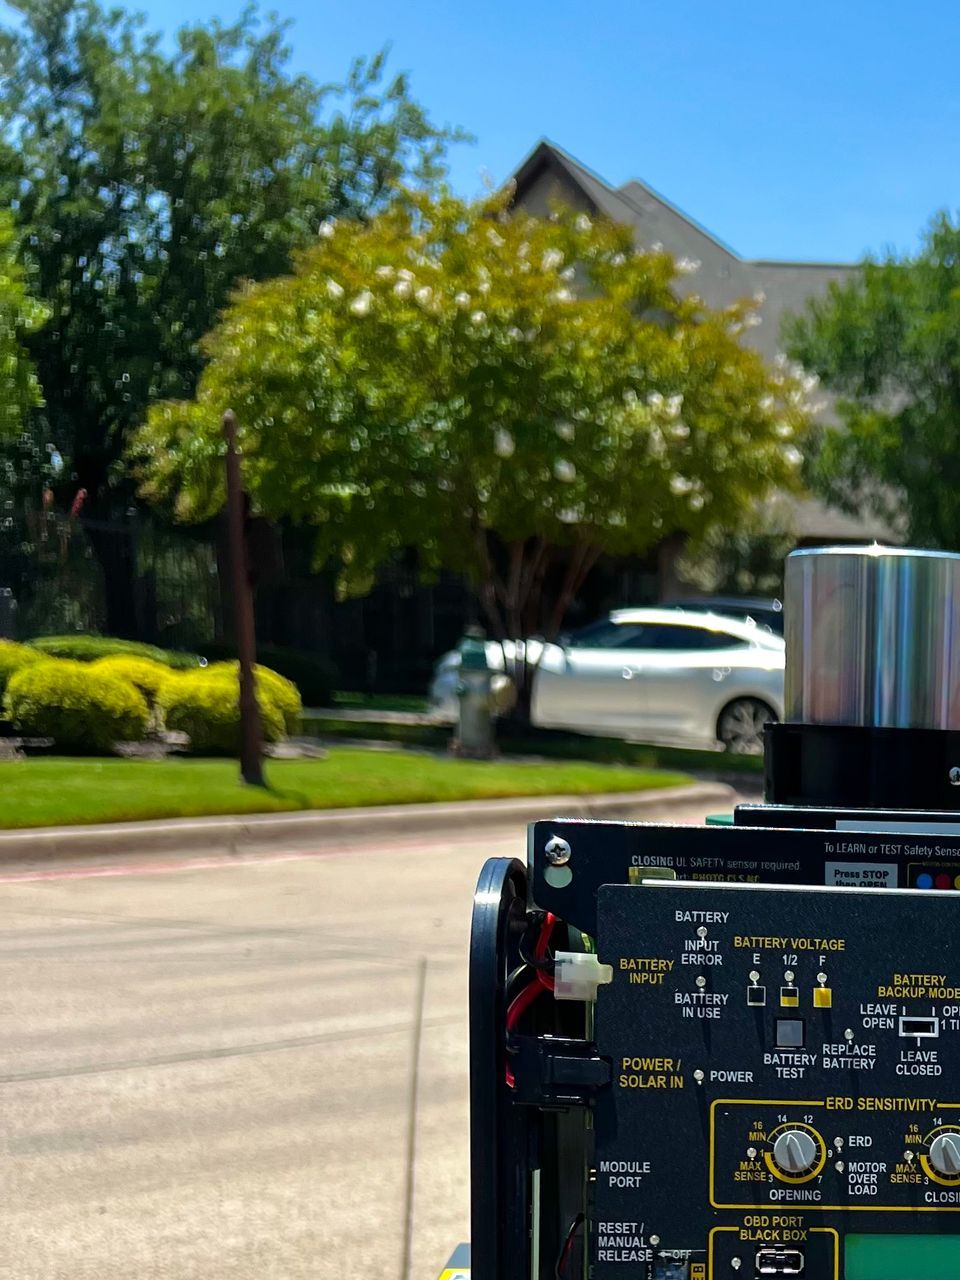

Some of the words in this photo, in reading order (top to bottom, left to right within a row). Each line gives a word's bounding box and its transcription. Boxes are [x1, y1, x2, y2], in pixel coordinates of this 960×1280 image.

[824, 842, 834, 852] To
[837, 843, 866, 853] LEARN
[869, 846, 878, 854] or
[880, 844, 900, 854] TEST
[905, 845, 932, 857] Safety
[835, 870, 860, 878] Press
[863, 871, 888, 879] STOP
[675, 911, 729, 923] BATTERY
[685, 940, 719, 952] INPUT
[734, 937, 788, 948] BATTERY
[791, 938, 845, 951] VOLTAGE
[620, 959, 674, 971] BATTERY
[682, 954, 723, 965] ERROR
[629, 972, 664, 984] INPUT
[894, 975, 946, 986] BATTERY
[878, 987, 926, 998] BACKUP
[675, 993, 728, 1005] BATTERY
[682, 1006, 695, 1018] IN
[698, 1007, 721, 1019] USE
[860, 1004, 897, 1015] LEAVE
[863, 1018, 894, 1029] OPEN
[823, 1045, 876, 1057] REPLACE
[764, 1054, 817, 1066] BATTERY
[901, 1051, 937, 1063] LEAVE
[622, 1058, 672, 1071] POWER
[677, 1060, 681, 1071] /
[823, 1058, 876, 1069] BATTERY
[776, 1068, 804, 1079] TEST
[896, 1064, 942, 1076] CLOSED
[619, 1075, 667, 1088] SOLAR
[670, 1076, 683, 1088] IN
[710, 1071, 753, 1083] POWER
[827, 1097, 853, 1109] ERD
[858, 1098, 936, 1111] SENSITIVITY
[600, 1162, 650, 1173] MODULE
[609, 1177, 641, 1188] PORT
[769, 1190, 821, 1201] OPENING
[744, 1216, 770, 1227] OBD
[773, 1217, 803, 1226] PORT
[598, 1223, 637, 1234] RESET
[740, 1230, 780, 1240] BLACK
[783, 1231, 807, 1240] BOX
[598, 1237, 647, 1247] MANUAL
[598, 1251, 653, 1262] RELEASE
